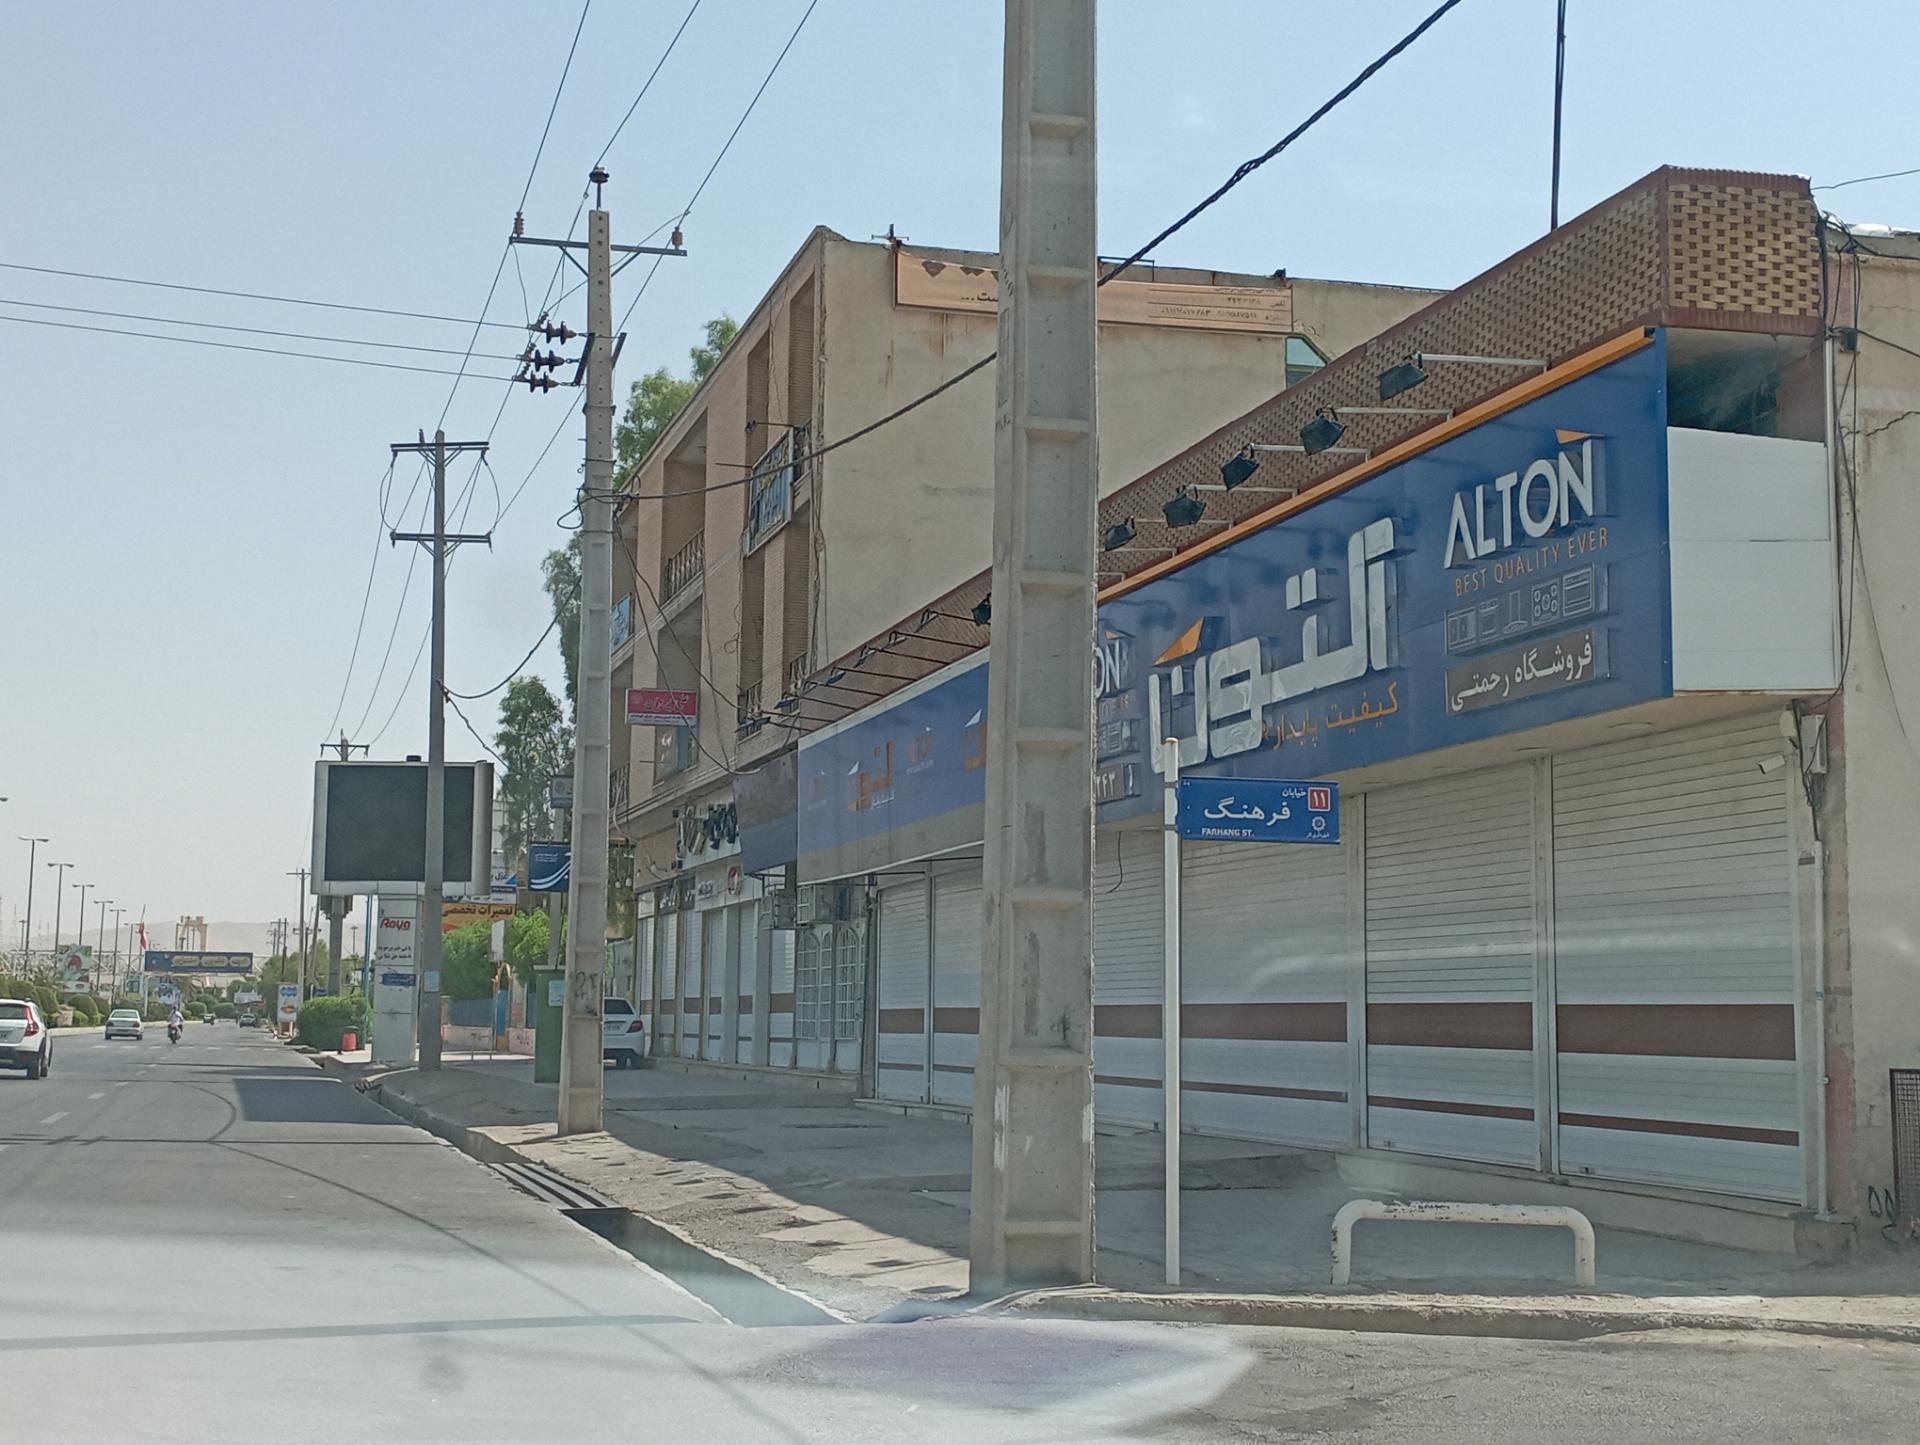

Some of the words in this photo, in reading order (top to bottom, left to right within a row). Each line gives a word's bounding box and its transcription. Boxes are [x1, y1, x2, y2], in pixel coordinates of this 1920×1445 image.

[1443, 438, 1593, 570] ALTON
[1454, 567, 1488, 597] BEST
[1494, 543, 1560, 585] QUALITY
[1567, 526, 1609, 559] EVER
[1514, 632, 1593, 684] فروشگاه
[1325, 680, 1400, 734] کیفیت
[1451, 671, 1511, 712] رحمتی
[1273, 708, 1320, 750] پایدار
[1203, 796, 1292, 826] فرهنگ
[1281, 786, 1307, 799] خیابان
[1312, 790, 1327, 808] ۱۱
[1201, 827, 1241, 837] FARHANG
[1241, 829, 1255, 838] ST.
